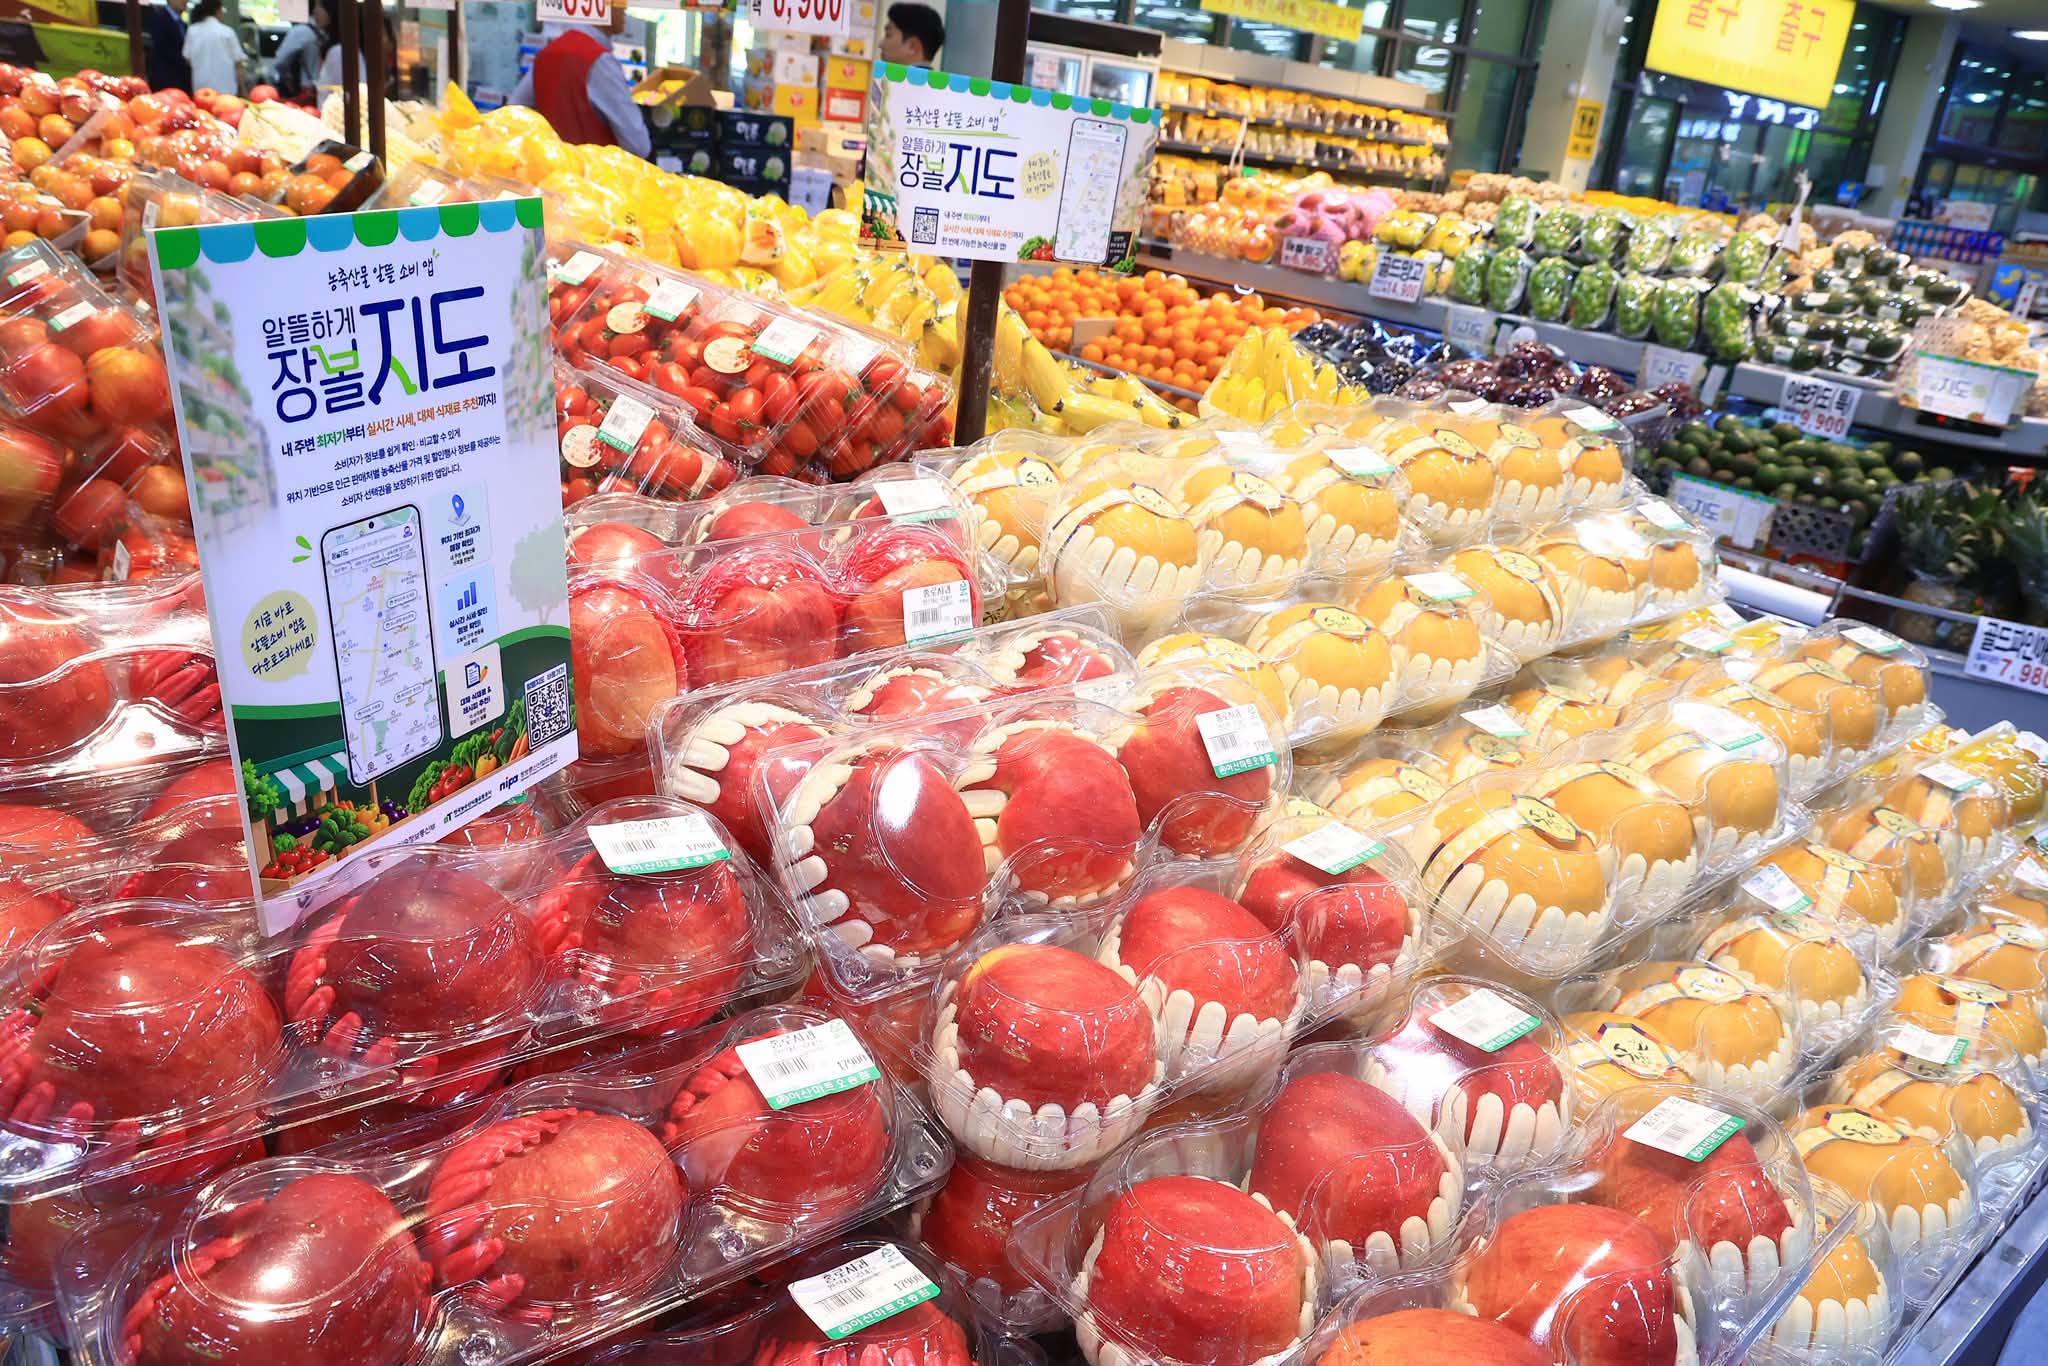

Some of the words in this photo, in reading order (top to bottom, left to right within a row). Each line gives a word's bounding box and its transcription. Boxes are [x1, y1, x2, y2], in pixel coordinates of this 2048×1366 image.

[902, 135, 947, 155] 알뜰하게
[328, 265, 370, 293] 농축산물
[373, 263, 396, 284] 알뜰
[399, 260, 419, 280] 소비
[422, 257, 434, 277] 앱
[1378, 255, 1424, 282] 골드망고
[262, 306, 356, 349] 알뜰하게
[281, 442, 293, 457] 내
[294, 436, 316, 454] 주변
[316, 424, 366, 448] 최저가부터
[366, 417, 395, 437] 실시간
[417, 406, 435, 422] 대체
[436, 401, 461, 417] 식재료
[462, 392, 497, 411] 추천까지!
[334, 453, 363, 471] 소비자가
[364, 447, 386, 463] 정보를
[386, 445, 401, 457] 쉽게
[440, 433, 447, 442] 수
[447, 428, 461, 440] 있게
[286, 490, 303, 504] 위치
[304, 481, 335, 498] 기반으로
[335, 476, 351, 490] 인근
[381, 460, 408, 477] 농축산물
[409, 456, 423, 468] 가격
[458, 440, 476, 455] 정보를
[341, 494, 364, 507] 소비자
[364, 483, 393, 501] 선택권을
[393, 474, 420, 491] 보장하기
[420, 470, 434, 481] 위한
[253, 610, 273, 630] 지금
[274, 601, 294, 620] 바로
[250, 626, 287, 653] 알뜰소비
[288, 617, 307, 634] 앱을
[499, 774, 519, 792] nipa
